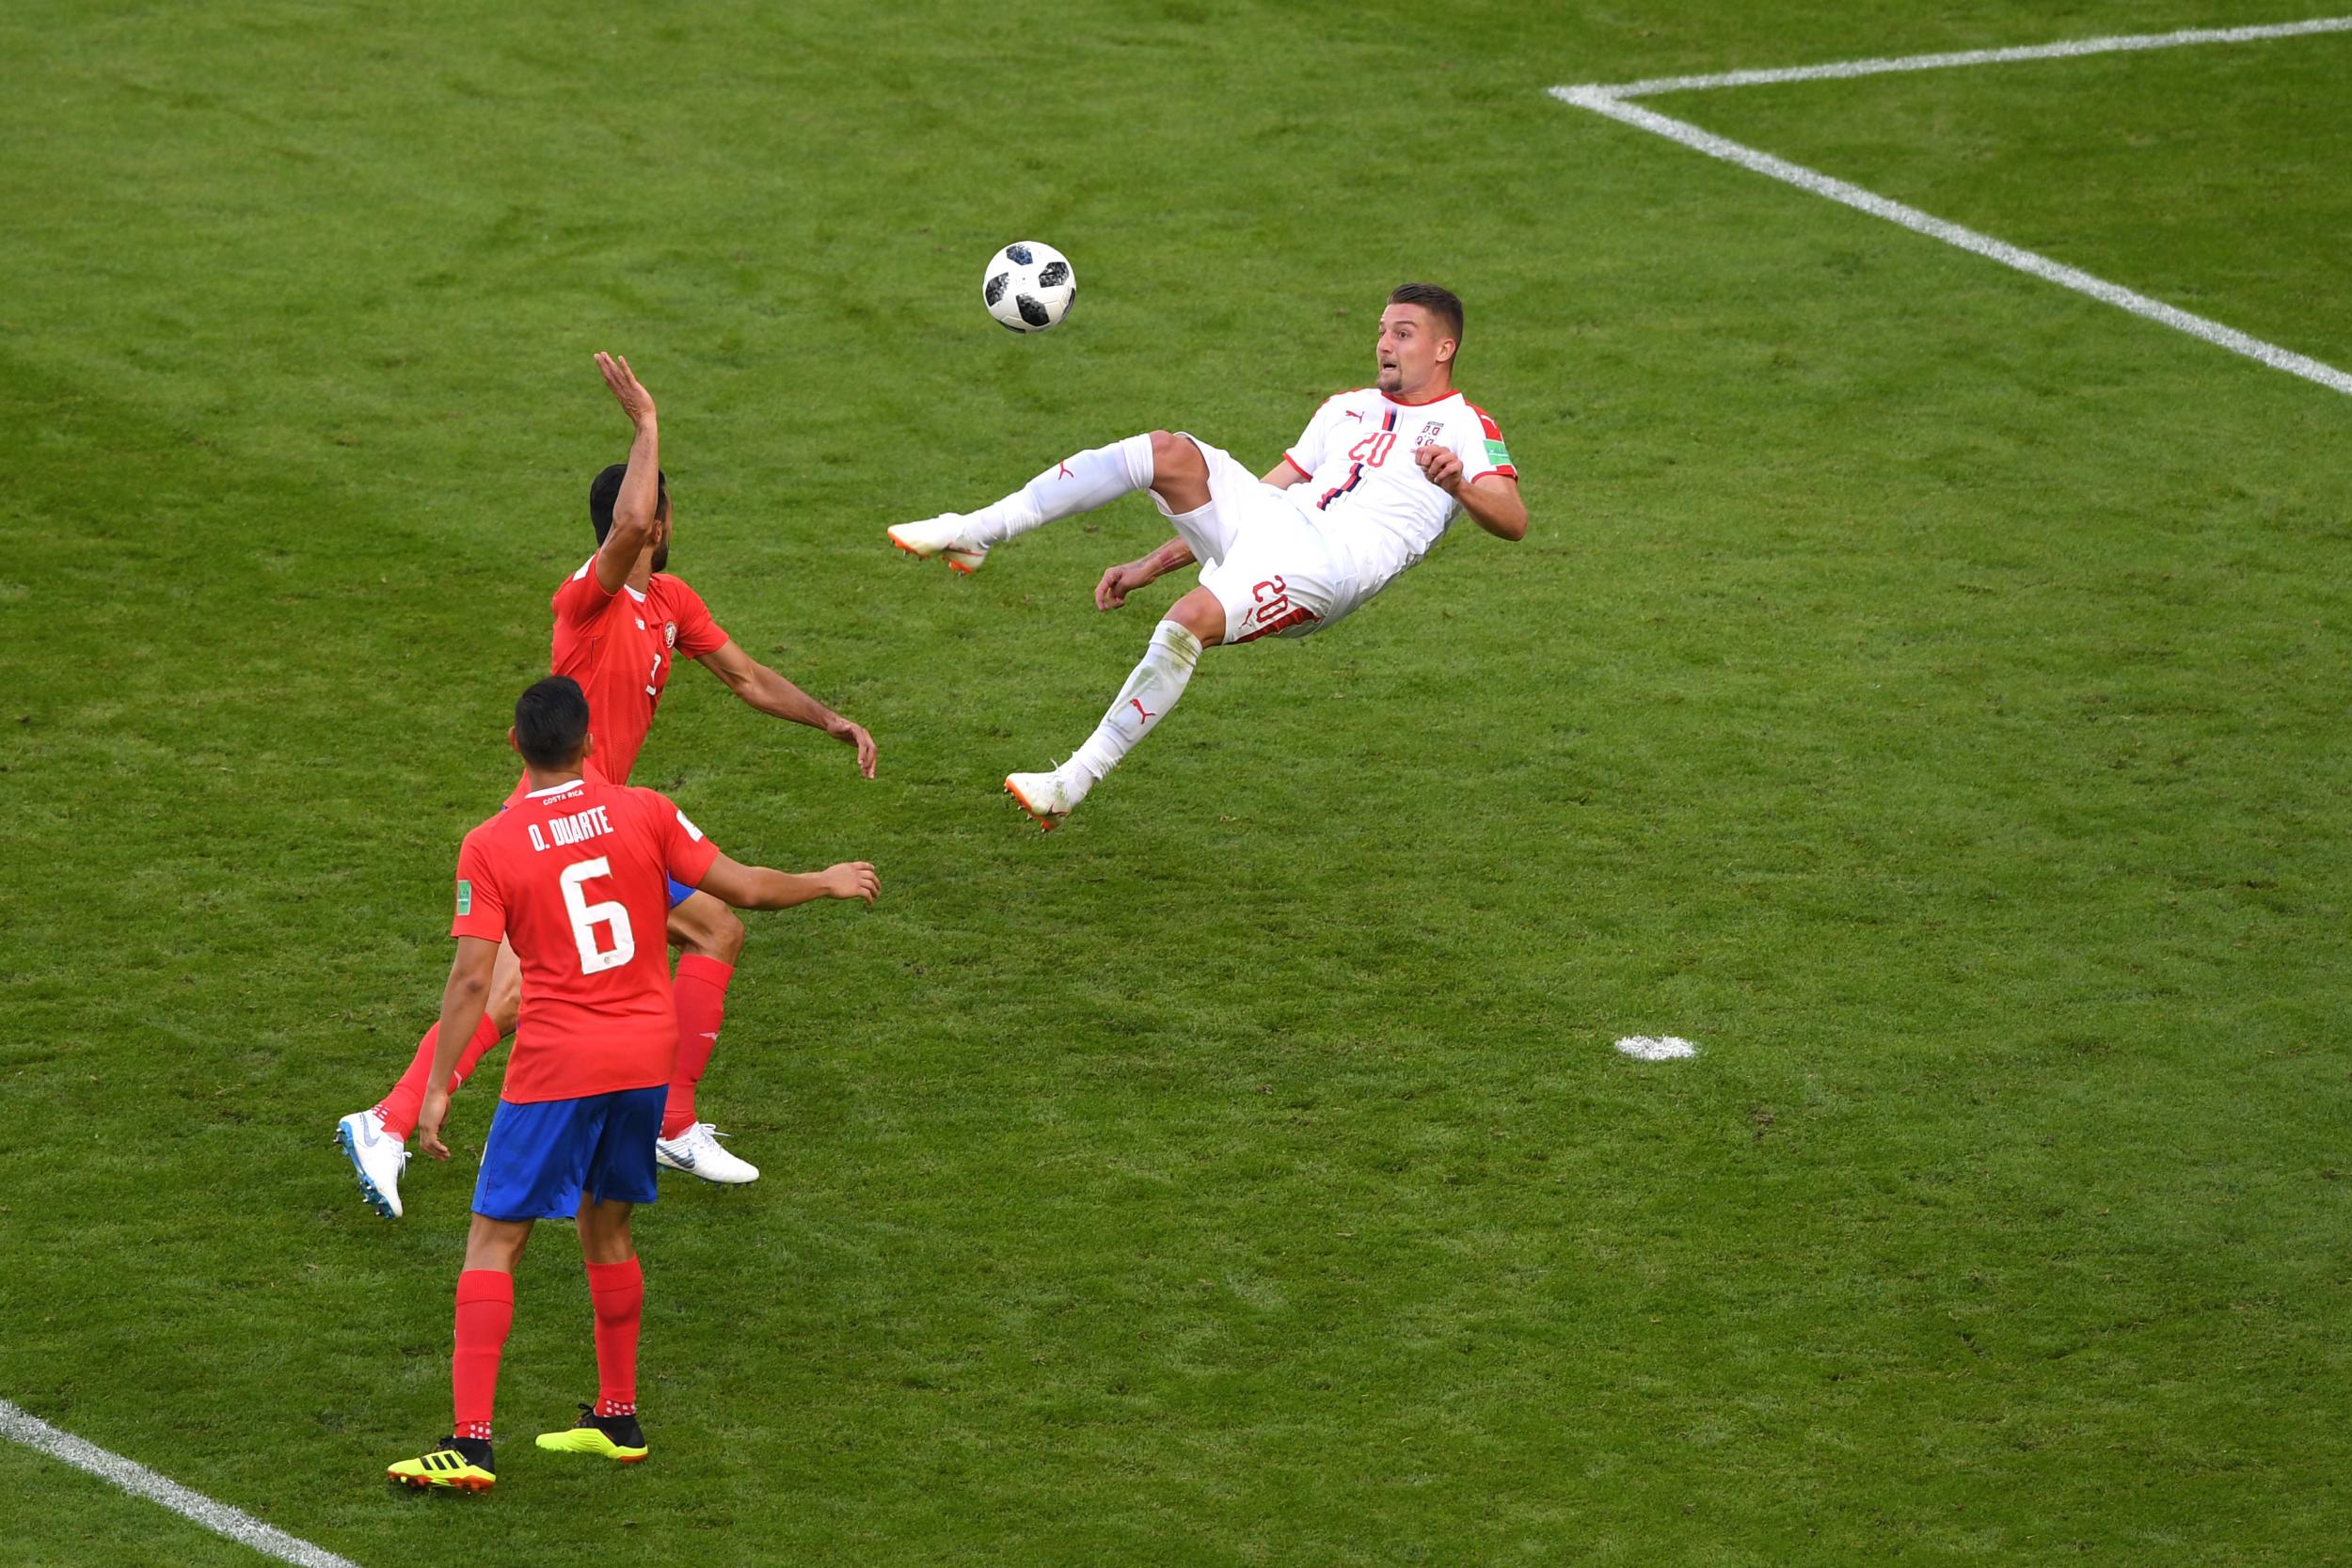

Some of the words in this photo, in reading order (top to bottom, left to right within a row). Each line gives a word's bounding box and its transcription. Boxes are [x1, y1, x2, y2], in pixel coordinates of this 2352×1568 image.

[1348, 432, 1397, 467] 20
[1252, 575, 1288, 623] 20
[543, 794, 566, 805] COSTA
[567, 789, 584, 799] RICA
[528, 824, 550, 852] O.
[548, 805, 614, 846] DUARTE
[560, 856, 636, 975] 6
